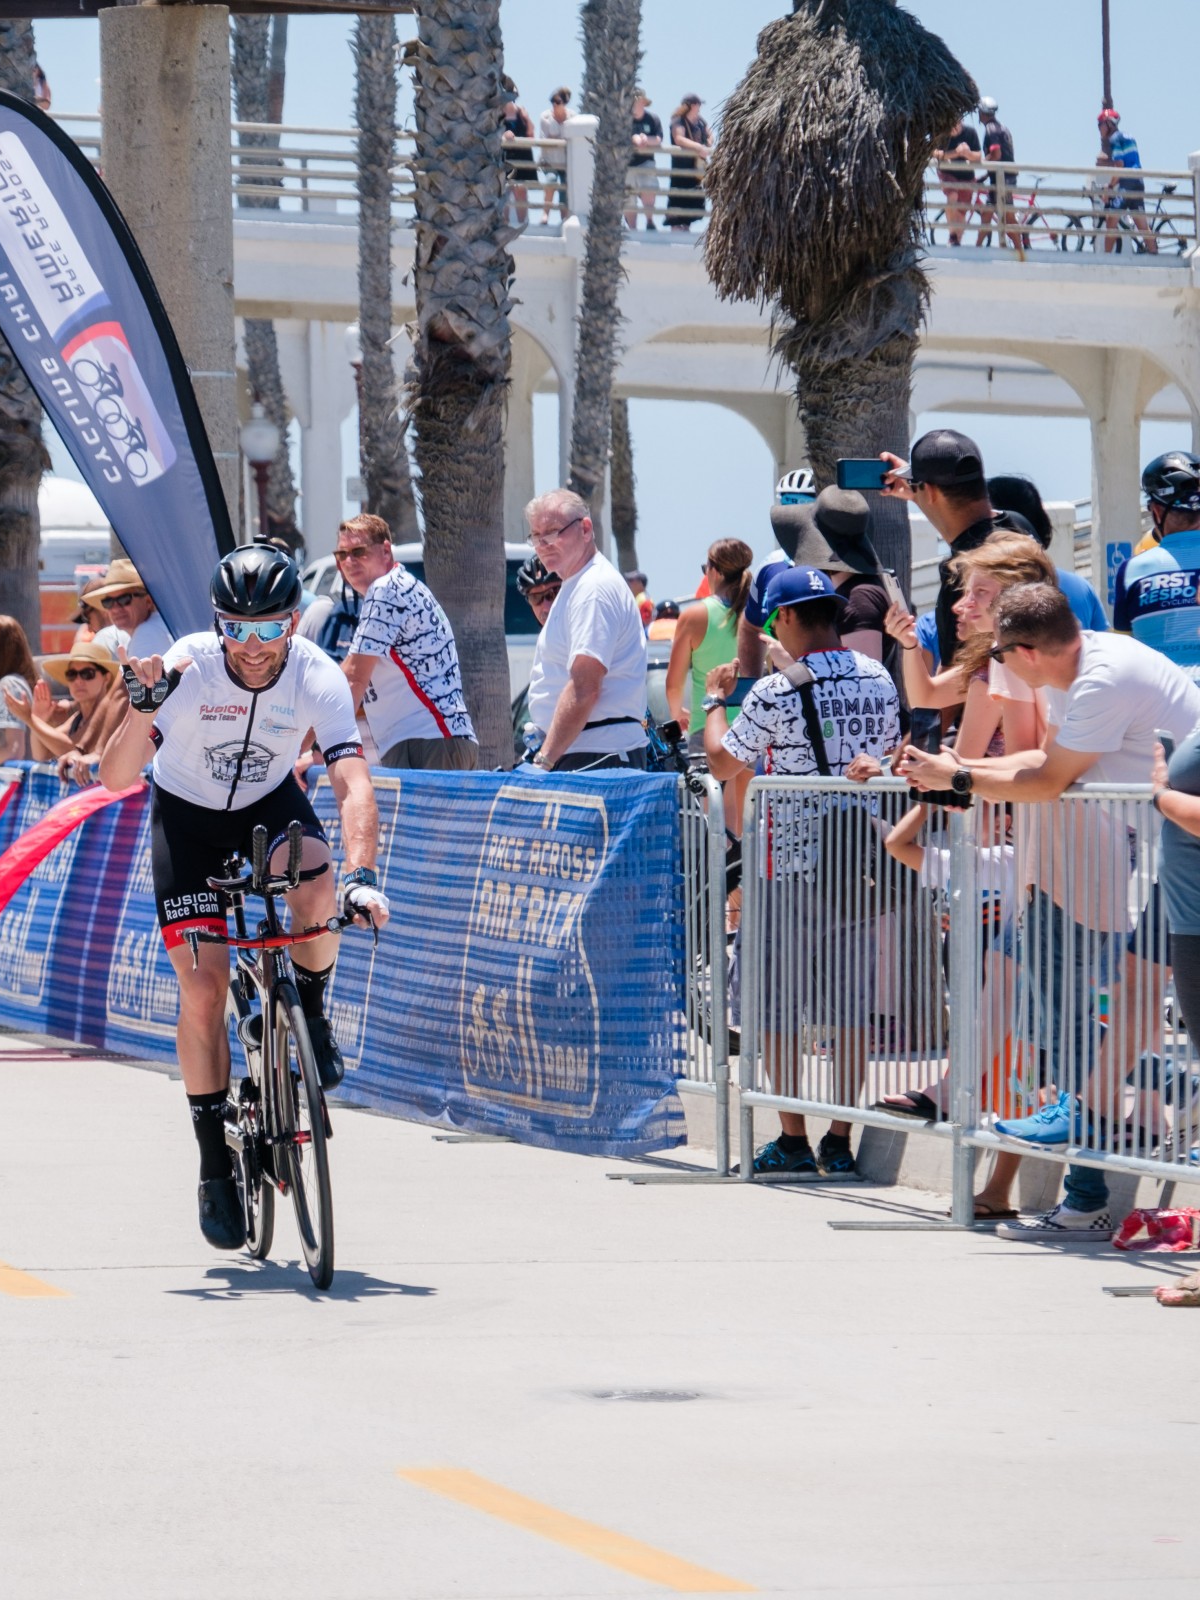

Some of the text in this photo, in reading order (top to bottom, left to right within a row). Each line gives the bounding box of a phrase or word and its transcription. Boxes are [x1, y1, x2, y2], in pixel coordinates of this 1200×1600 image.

[1140, 572, 1196, 594] FIRST
[200, 704, 248, 716] FUSION
[820, 697, 886, 719] ERMAN
[818, 717, 886, 738] 8TORS
[528, 840, 595, 883] ACROSS
[164, 892, 218, 910] FUSION
[166, 902, 219, 920] Race Team
[476, 880, 584, 950] AMERICA
